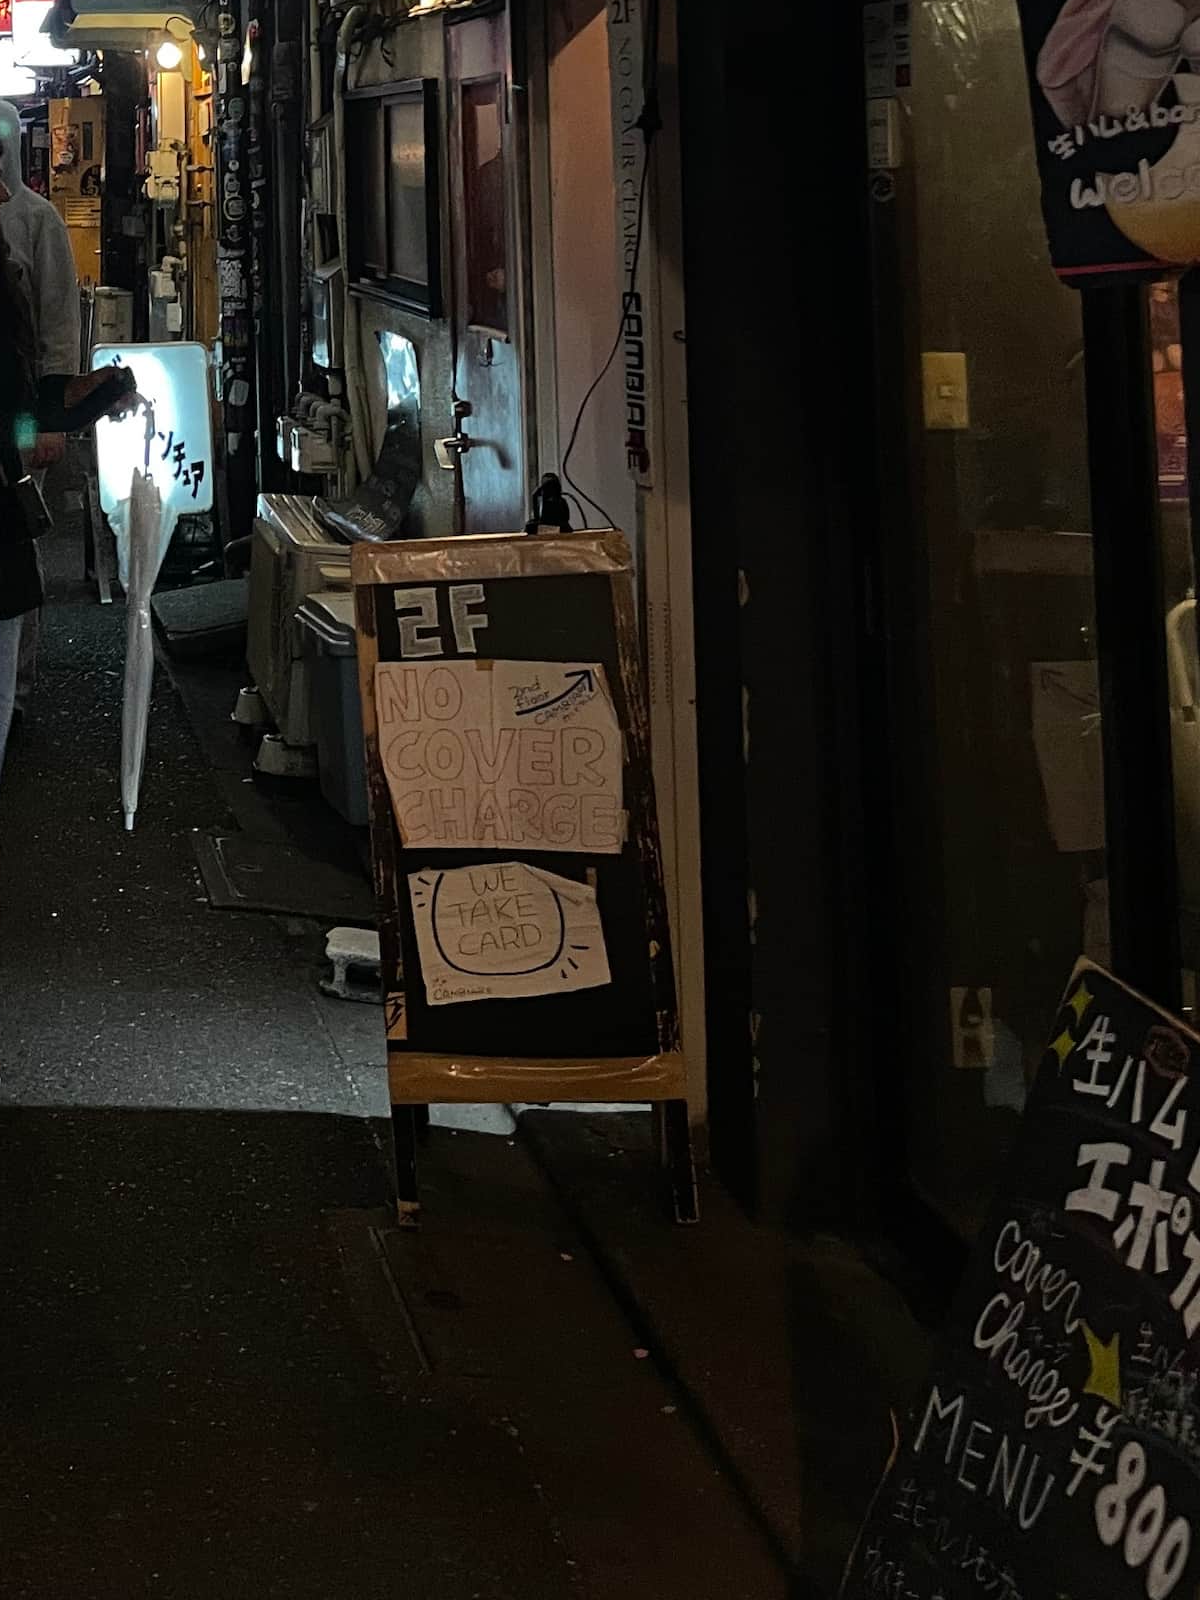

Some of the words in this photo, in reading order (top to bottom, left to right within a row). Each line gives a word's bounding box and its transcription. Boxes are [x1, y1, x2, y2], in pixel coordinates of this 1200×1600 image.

[612, 0, 636, 24] 2F
[394, 583, 489, 659] 2F
[378, 666, 463, 724] NO
[385, 727, 606, 787] COVER
[399, 787, 623, 848] CHARGE
[448, 893, 537, 927] TAKE
[469, 865, 519, 897] WE
[458, 923, 543, 956] CARD
[1072, 1014, 1190, 1151] 生ハム
[913, 1384, 1056, 1531] MENU
